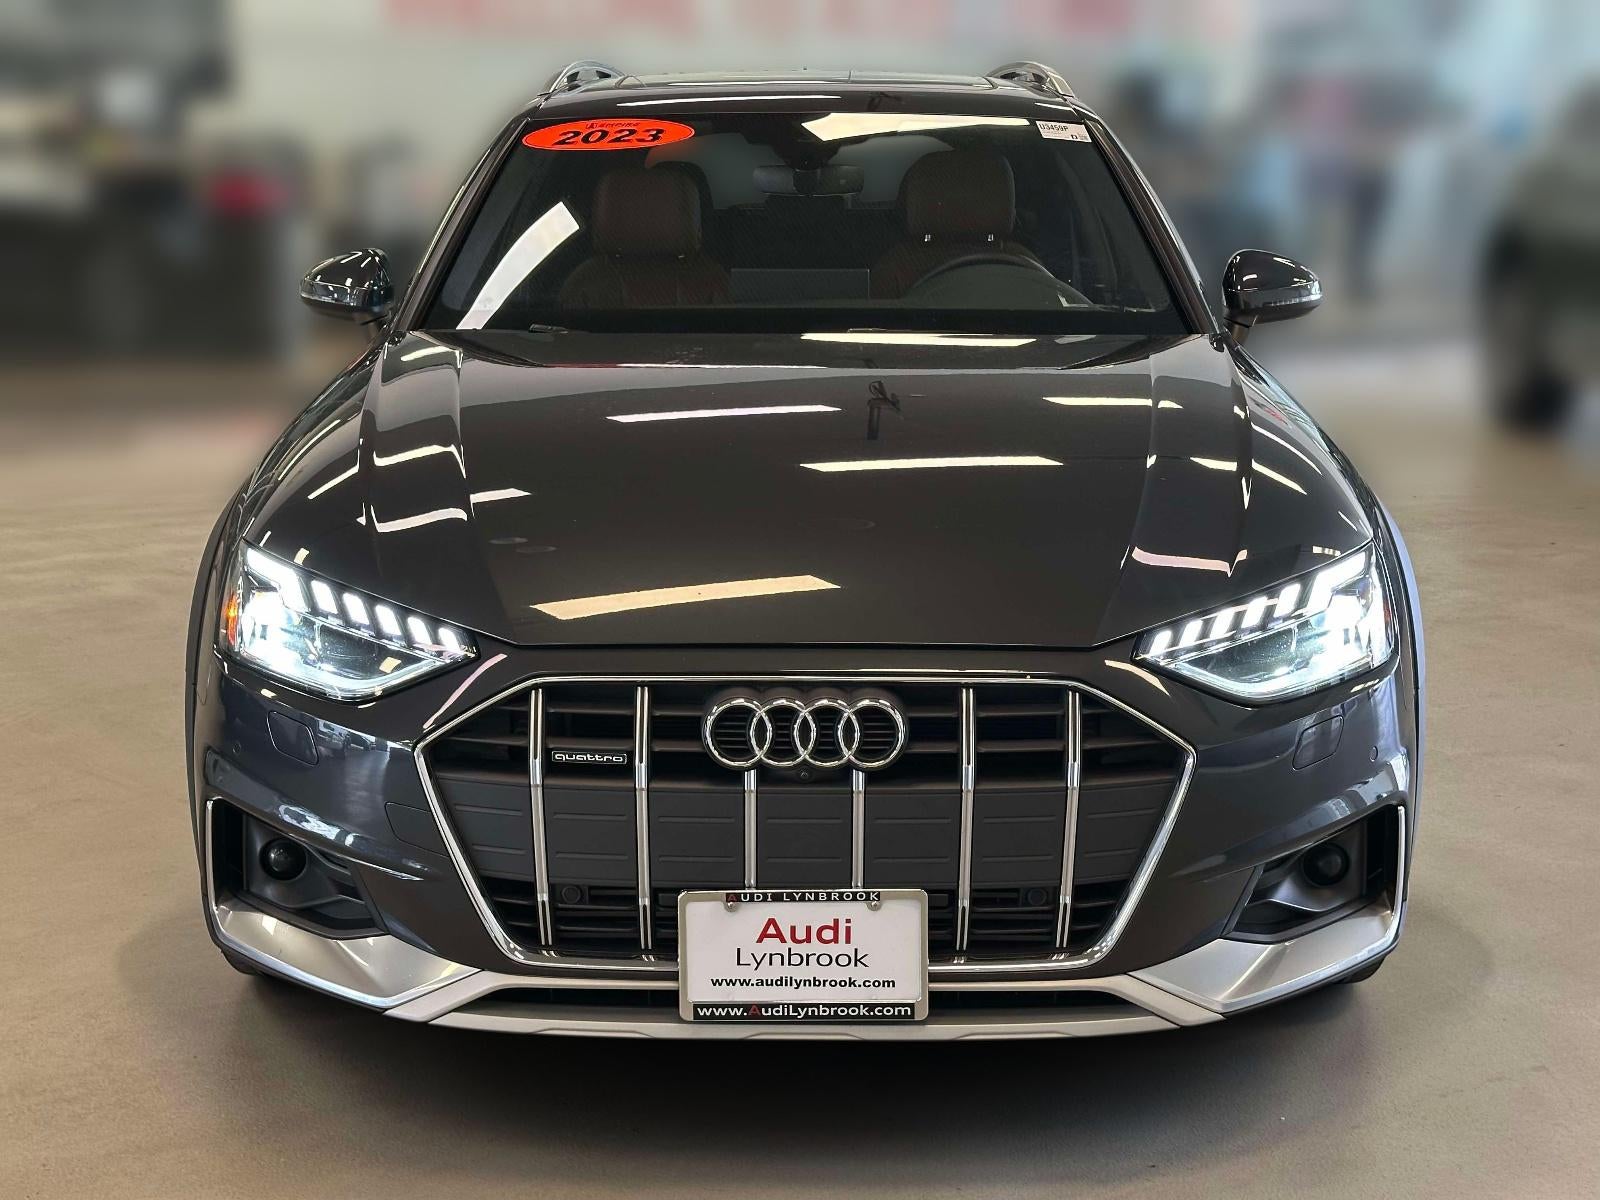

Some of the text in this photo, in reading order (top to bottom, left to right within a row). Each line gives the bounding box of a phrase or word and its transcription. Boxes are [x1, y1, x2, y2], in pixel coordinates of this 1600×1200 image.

[552, 129, 665, 145] 2023
[555, 753, 623, 761] quattro
[728, 892, 880, 901] AUDI LYNBROOK
[755, 917, 852, 944] Audi
[736, 947, 869, 970] Lynbrook
[710, 976, 896, 989] www.audilynbrook.com
[697, 1003, 911, 1017] www.AudiLynbrook.com
